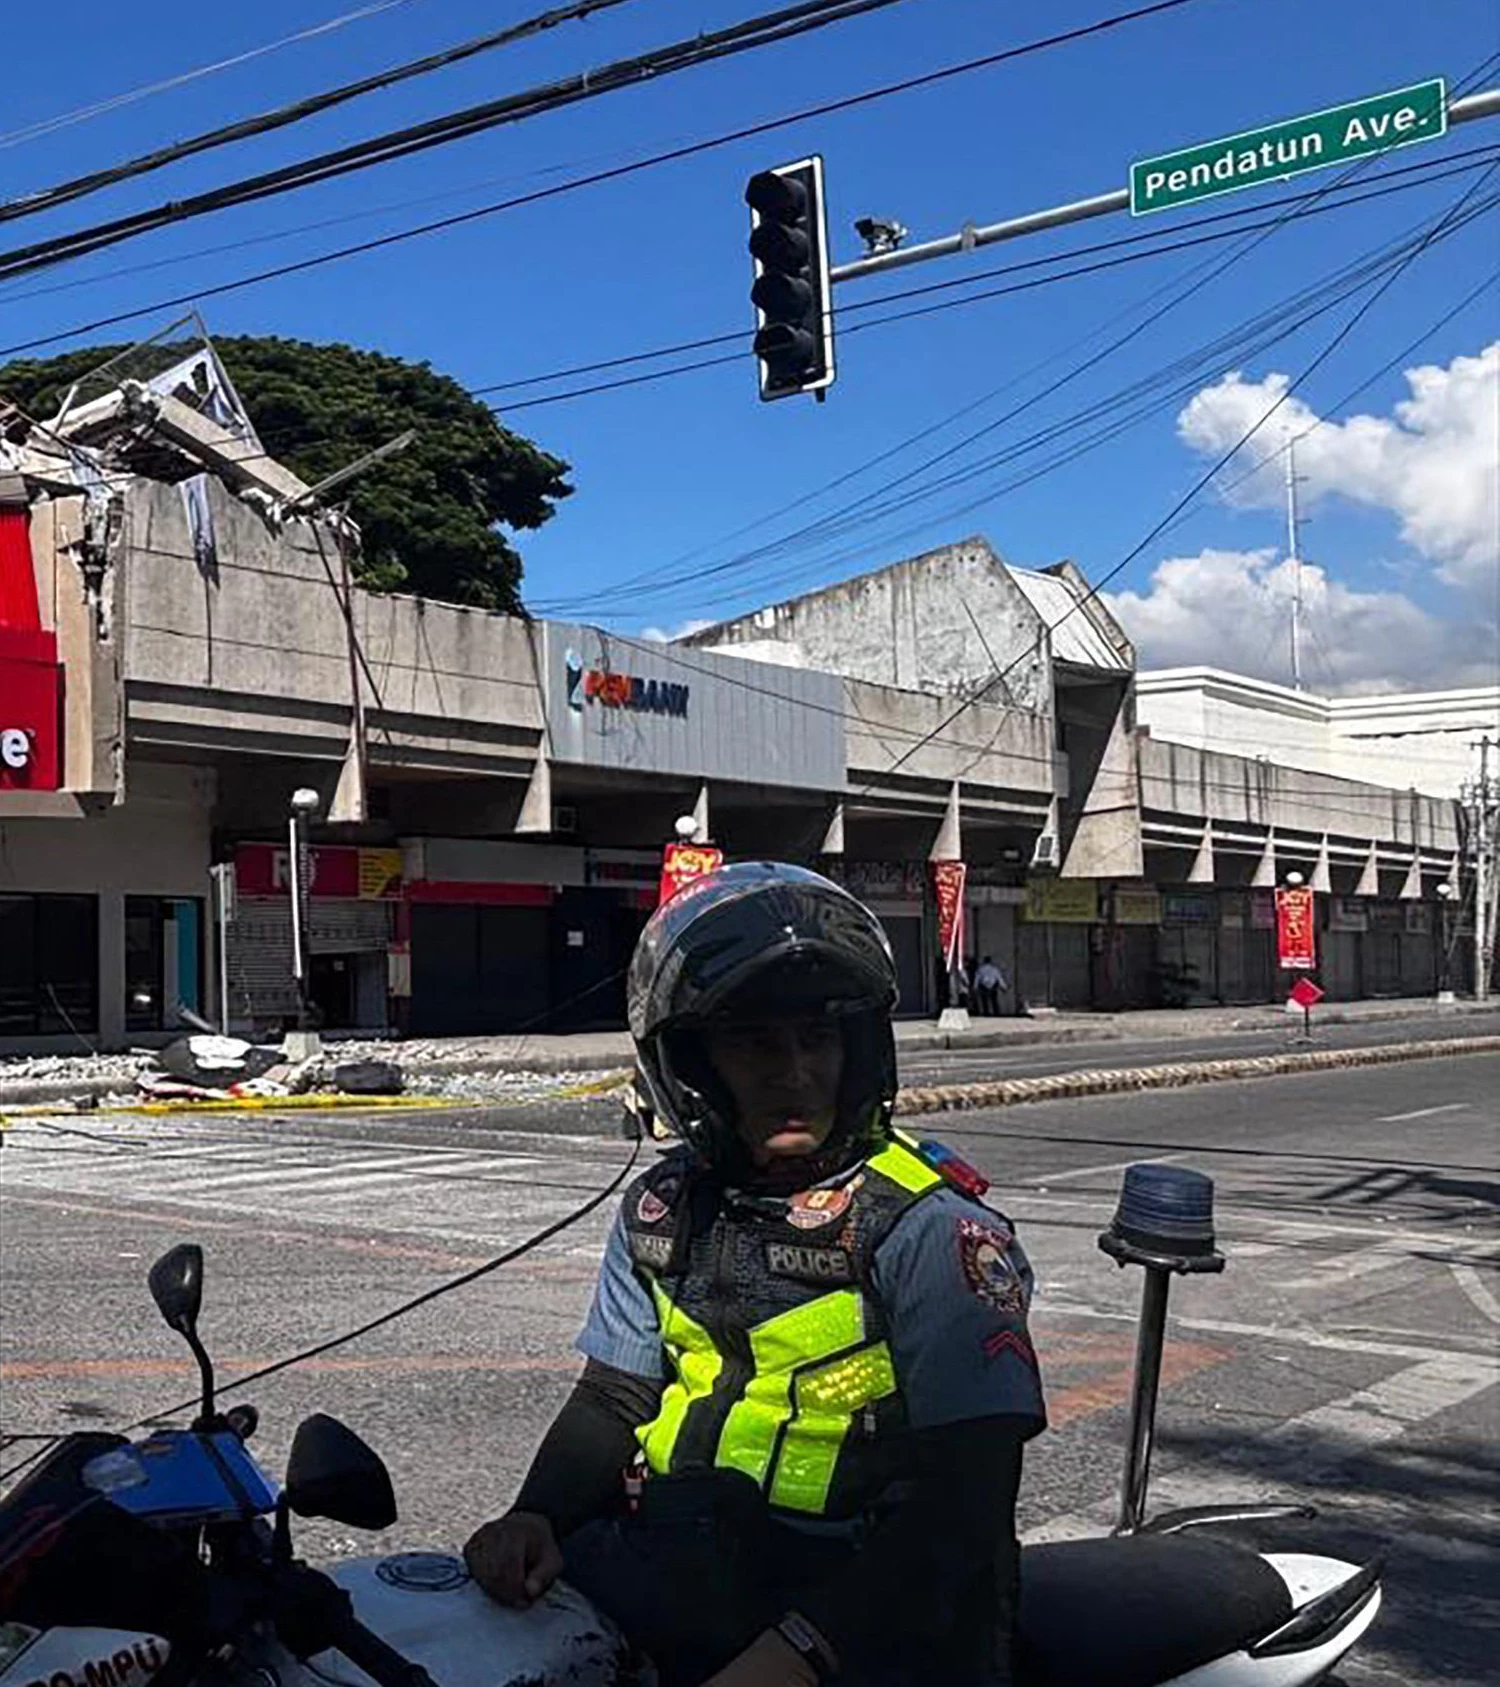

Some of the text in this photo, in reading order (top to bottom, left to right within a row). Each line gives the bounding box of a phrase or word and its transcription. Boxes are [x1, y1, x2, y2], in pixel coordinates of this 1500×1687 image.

[1145, 106, 1428, 199] Pendatun Ave.
[768, 1243, 847, 1277] POLICE
